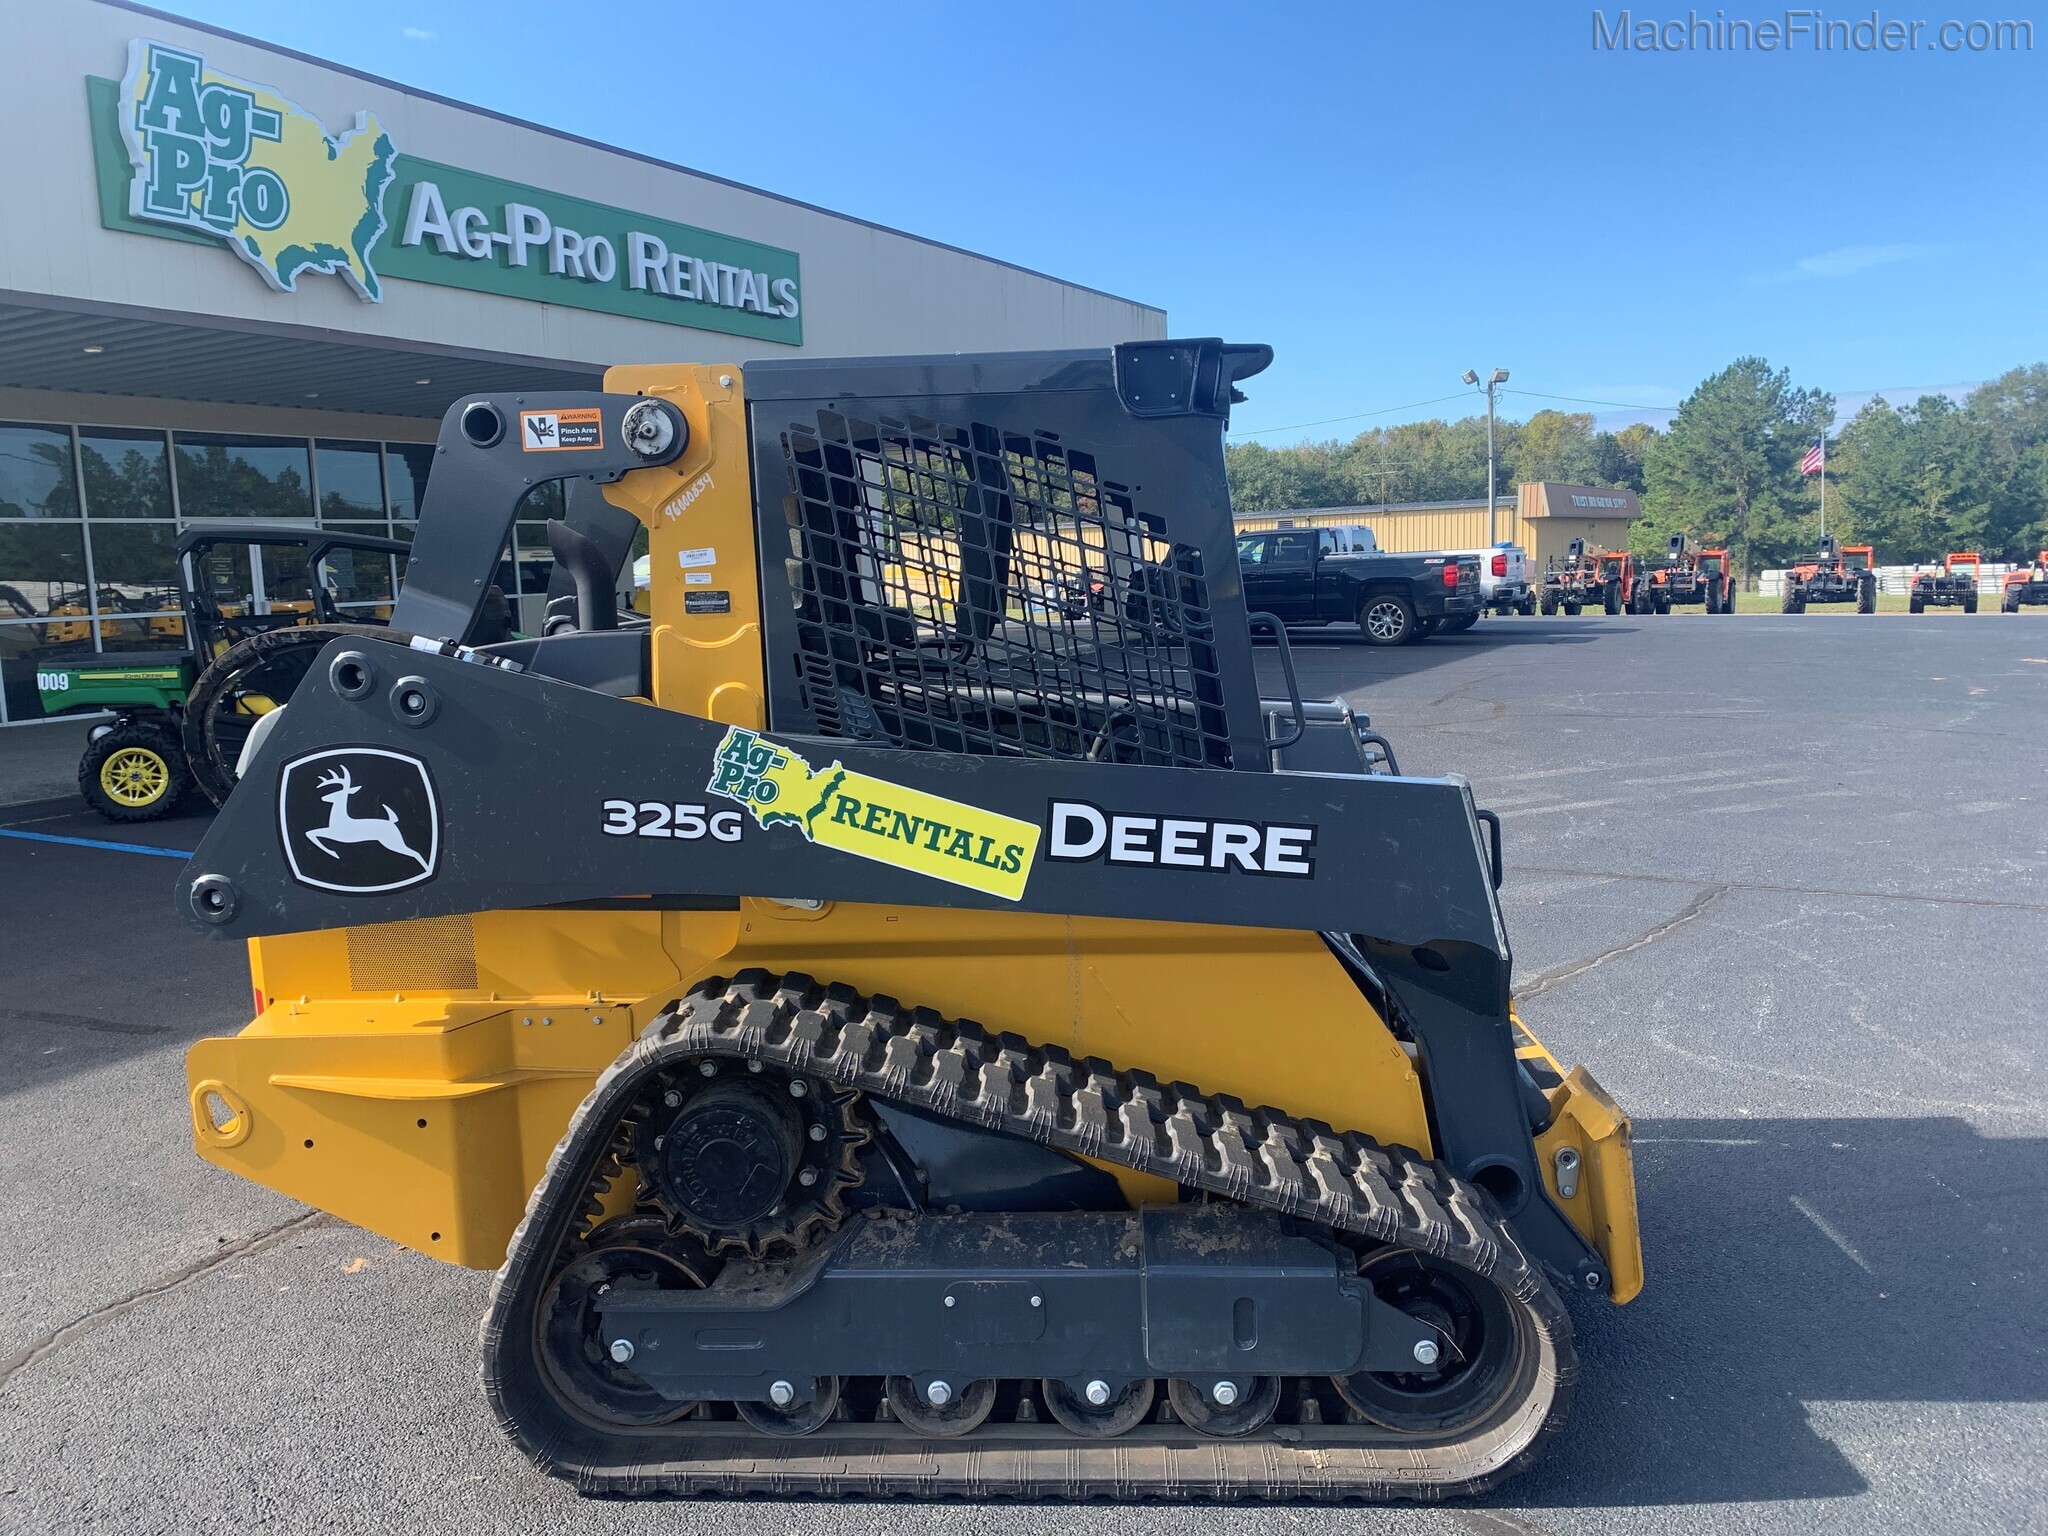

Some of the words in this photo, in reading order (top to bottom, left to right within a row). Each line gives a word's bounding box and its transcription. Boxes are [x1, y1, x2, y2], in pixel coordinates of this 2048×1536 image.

[138, 46, 281, 163] Ag-
[146, 131, 288, 229] Pro
[402, 181, 616, 283] AG-PRO
[627, 231, 799, 319] RENTALS
[706, 760, 780, 804] Pro
[718, 728, 788, 780] Ag-
[602, 800, 742, 842] 325G
[830, 794, 1025, 875] RENTALS
[1049, 802, 1312, 875] DEERE
